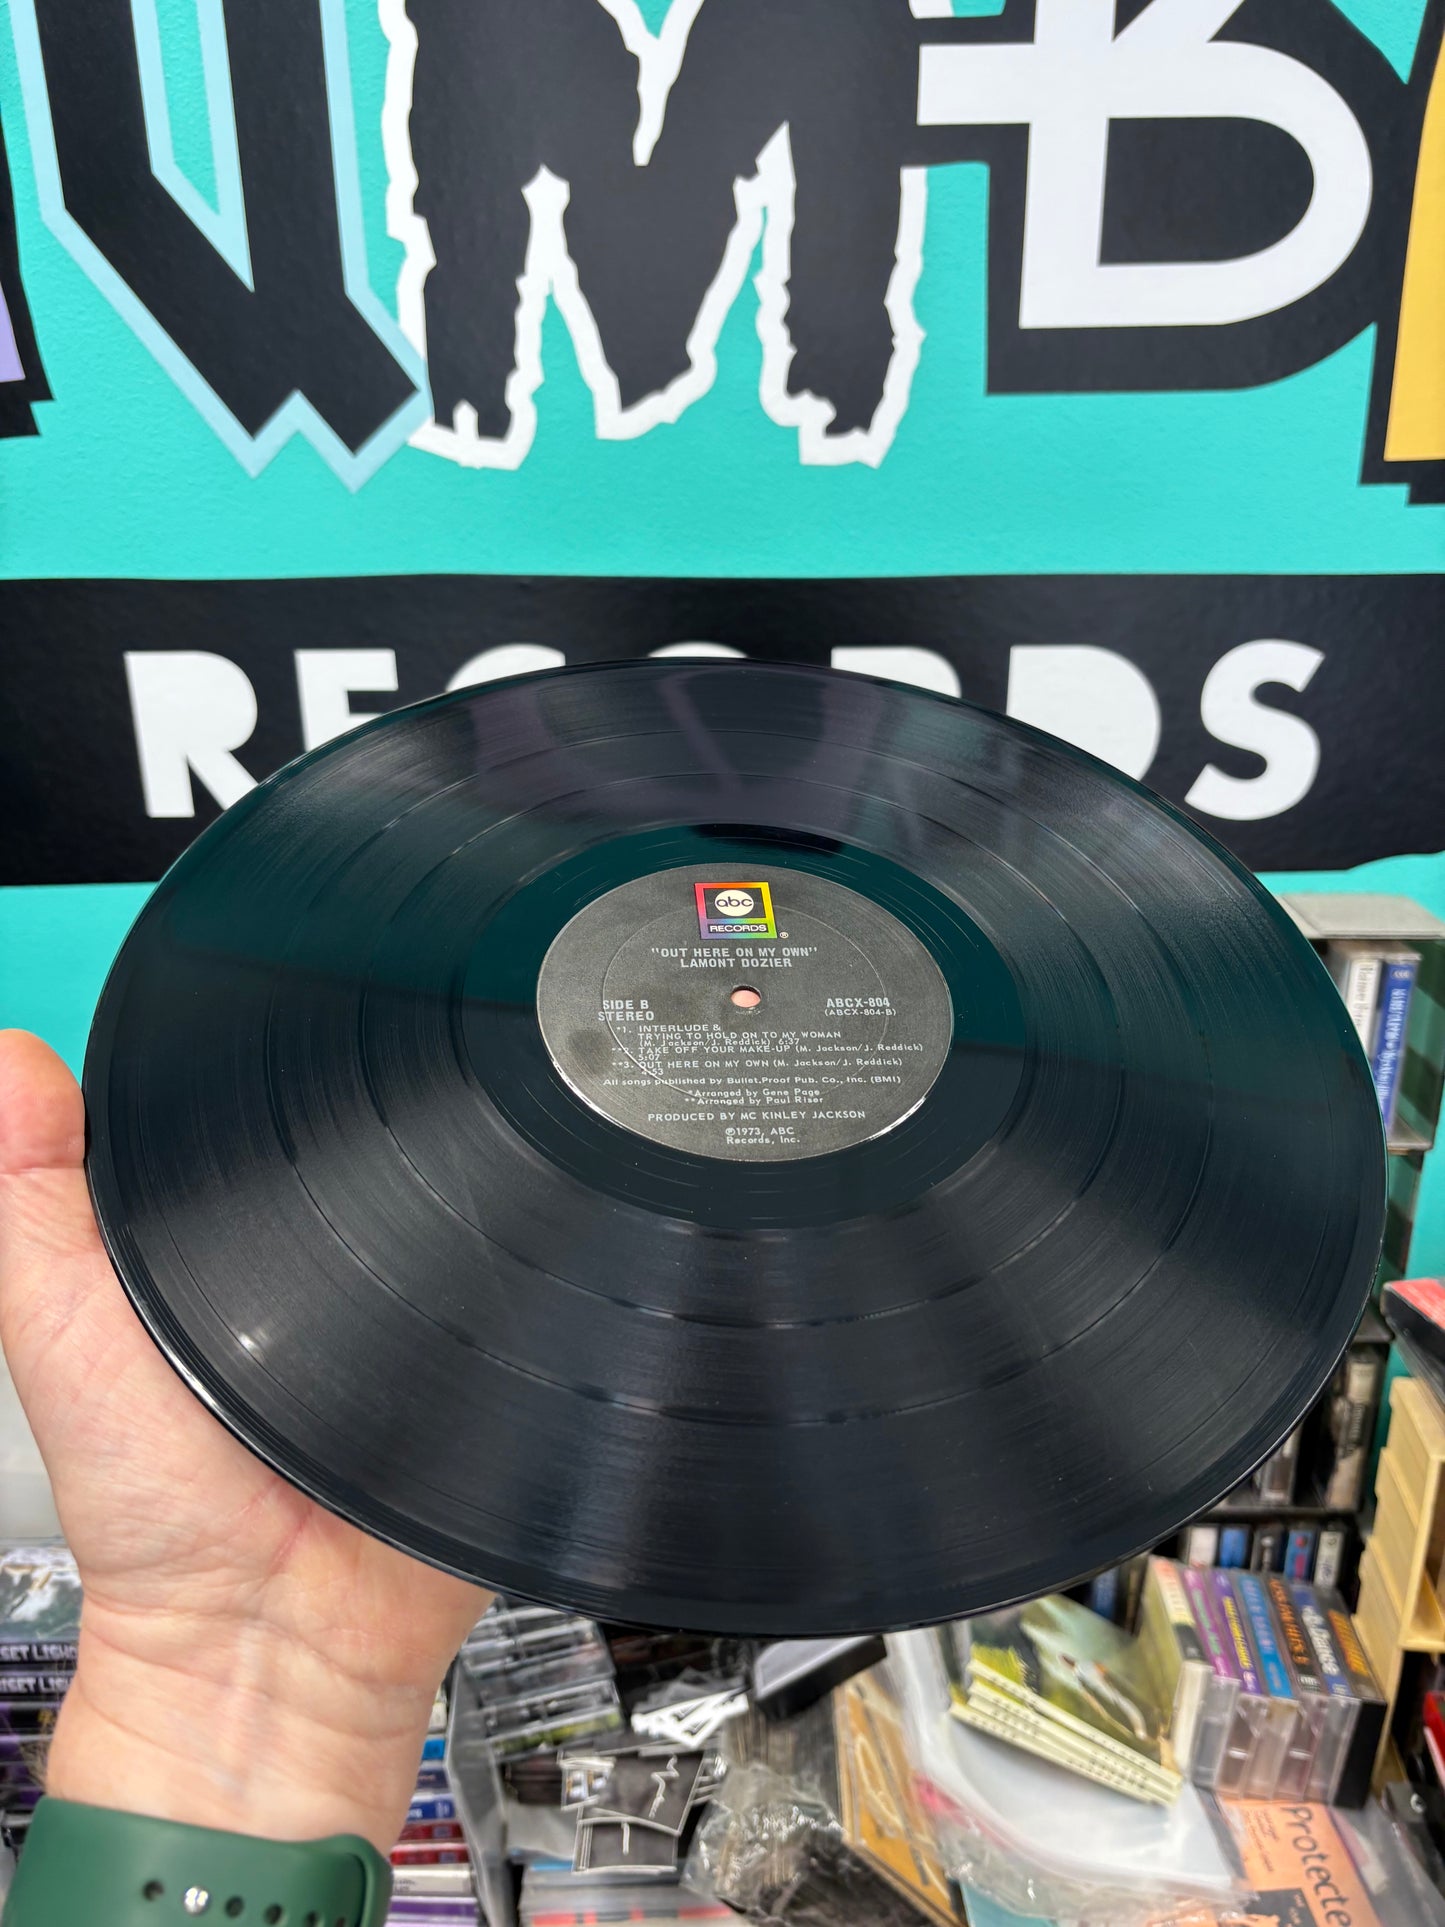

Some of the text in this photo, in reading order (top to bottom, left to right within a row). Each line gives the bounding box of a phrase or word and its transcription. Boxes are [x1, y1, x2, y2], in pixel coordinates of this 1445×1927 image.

[716, 896, 753, 908] abc
[709, 924, 767, 932] RECORDS
[694, 947, 730, 957] HERE
[735, 947, 753, 957] ON
[759, 947, 775, 957] MY
[681, 958, 792, 968] LAMONT DOZIER
[602, 1000, 649, 1010] SIDE B
[826, 997, 890, 1008] ABCX-804
[597, 1011, 655, 1021] STEREO
[712, 1024, 721, 1032] &
[725, 1038, 771, 1047] Reddick)
[877, 1044, 923, 1052] Reddick)
[704, 1060, 720, 1068] ON
[856, 1058, 902, 1066] Reddick)
[622, 1079, 651, 1087] songs
[655, 1078, 705, 1086] published
[710, 1077, 722, 1085] by
[870, 1075, 901, 1084] (BMI)
[746, 1089, 758, 1097] by
[762, 1088, 789, 1096] Gene
[794, 1088, 820, 1096] Page
[750, 1097, 761, 1105] by
[766, 1096, 790, 1104] Paul
[648, 1113, 714, 1121] PRODUCED
[812, 1111, 866, 1119] JACKSON
[770, 1127, 795, 1135] ABC
[726, 1135, 800, 1145] Records, Inc.
